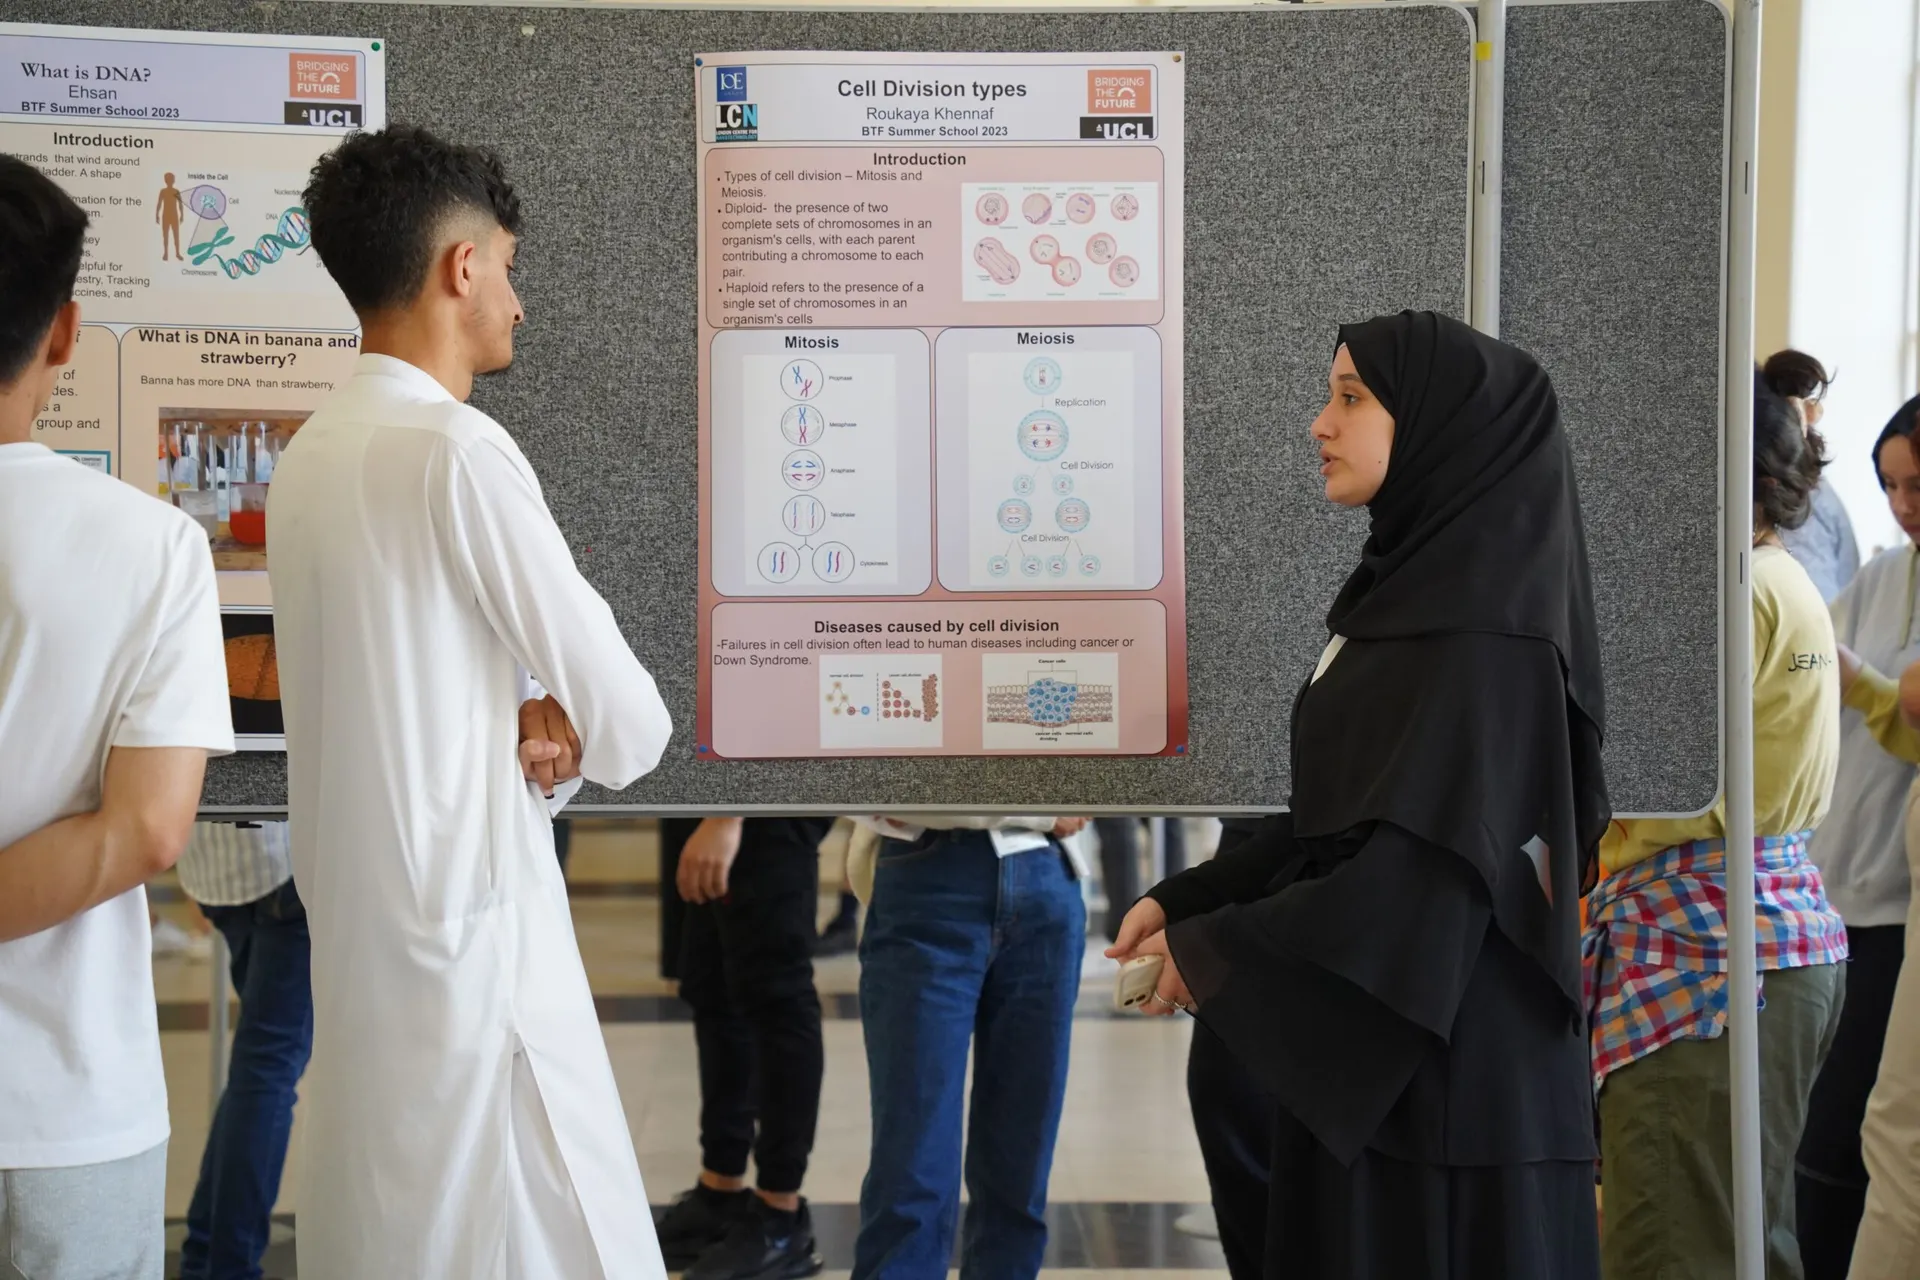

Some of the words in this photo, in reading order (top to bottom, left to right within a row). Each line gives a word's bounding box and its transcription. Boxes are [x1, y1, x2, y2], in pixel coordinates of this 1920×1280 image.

[21, 62, 69, 78] What
[76, 65, 88, 79] is
[96, 66, 151, 82] DNA?
[297, 61, 349, 72] BRIDGING
[297, 72, 318, 82] THE
[1095, 77, 1144, 87] BRIDGING
[69, 85, 117, 100] Ehsan
[298, 83, 340, 94] FUTURE
[838, 80, 876, 97] Cell
[884, 80, 965, 97] Division
[972, 81, 1027, 101] types
[1095, 88, 1115, 97] THE
[22, 102, 46, 112] BTF
[50, 103, 100, 114] Summer
[105, 105, 147, 116] School
[152, 108, 179, 118] 2023
[1095, 99, 1136, 108] FUTURE
[310, 109, 358, 127] UCL
[716, 104, 757, 128] LCN
[866, 107, 929, 123] Roukaya
[934, 107, 994, 120] Khennaf
[862, 127, 884, 136] BTF
[888, 126, 936, 136] Summer
[939, 126, 978, 136] School
[982, 126, 1008, 136] 2023
[1104, 122, 1150, 140] UCL
[54, 132, 153, 148] Introduction
[12, 153, 48, 162] trands
[55, 154, 74, 164] that
[77, 156, 101, 164] wind
[104, 157, 140, 166] around
[873, 152, 966, 166] Introduction
[42, 168, 77, 177] ladder.
[80, 168, 87, 177] A
[90, 169, 121, 180] shape
[724, 171, 757, 184] Types
[760, 170, 772, 181] of
[774, 170, 794, 181] cell
[798, 170, 842, 181] division
[856, 170, 897, 180] Mitosis
[900, 170, 922, 180] and
[722, 187, 766, 198] Meiosis.
[70, 196, 106, 205] mation
[109, 196, 122, 205] for
[126, 197, 141, 206] the
[725, 202, 767, 216] Diploid-
[774, 202, 792, 213] the
[796, 204, 850, 215] presence
[853, 202, 865, 213] of
[868, 203, 888, 213] two
[722, 219, 772, 232] complete
[776, 219, 799, 229] sets
[803, 218, 814, 229] of
[818, 218, 900, 229] chromosomes
[904, 218, 913, 229] in
[917, 221, 932, 229] an
[722, 234, 782, 248] organism's
[785, 234, 815, 246] cells,
[819, 234, 842, 245] with
[846, 234, 874, 245] each
[878, 235, 915, 247] parent
[722, 251, 787, 264] contributing
[791, 253, 798, 261] a
[801, 250, 877, 261] chromosome
[881, 251, 892, 260] to
[895, 250, 924, 260] each
[80, 262, 106, 271] elpful
[109, 262, 122, 271] for
[722, 268, 745, 280] pair.
[76, 276, 103, 286] estry.
[107, 275, 150, 287] Tracking
[73, 288, 110, 298] ccines,
[114, 290, 132, 298] and
[726, 282, 768, 295] Haploid
[772, 282, 804, 292] refers
[809, 283, 819, 292] to
[823, 282, 841, 292] the
[845, 283, 898, 295] presence
[902, 281, 913, 292] of
[916, 284, 924, 292] a
[723, 298, 755, 311] single
[758, 299, 776, 308] set
[779, 298, 791, 308] of
[794, 298, 876, 308] chromosomes
[880, 298, 889, 308] in
[893, 300, 907, 308] an
[723, 314, 783, 328] organism's
[787, 314, 813, 324] cells
[139, 329, 180, 343] What
[186, 330, 198, 343] is
[204, 331, 240, 345] DNA
[245, 332, 259, 345] in
[265, 333, 322, 347] banana
[328, 335, 357, 348] and
[785, 336, 839, 349] Mitosis
[1017, 332, 1075, 345] Meiosis
[201, 352, 296, 368] strawberry?
[63, 369, 76, 380] of
[141, 375, 173, 385] Banna
[177, 376, 195, 386] has
[198, 379, 224, 387] more
[227, 378, 250, 387] DNA
[256, 379, 278, 388] than
[281, 380, 335, 390] strawberry.
[53, 403, 60, 412] a
[1055, 398, 1106, 408] Replication
[36, 419, 72, 430] group
[77, 419, 100, 429] and
[1061, 461, 1078, 470] Cell
[1081, 461, 1113, 470] Division
[1021, 534, 1037, 542] Cell
[1039, 534, 1069, 542] Division
[814, 621, 882, 633] Diseases
[887, 620, 941, 633] caused
[947, 620, 964, 635] by
[969, 620, 995, 632] cell
[1000, 619, 1059, 632] division
[716, 639, 766, 650] -Failures
[770, 639, 780, 649] in
[784, 639, 803, 649] cell
[807, 639, 849, 649] division
[853, 638, 882, 649] often
[885, 638, 909, 648] lead
[913, 639, 924, 648] to
[928, 638, 967, 648] human
[971, 638, 1022, 648] diseases
[1025, 637, 1076, 650] including
[1080, 638, 1118, 647] cancer
[1122, 639, 1134, 647] or
[714, 655, 746, 665] Down
[750, 654, 812, 667] Syndrome.
